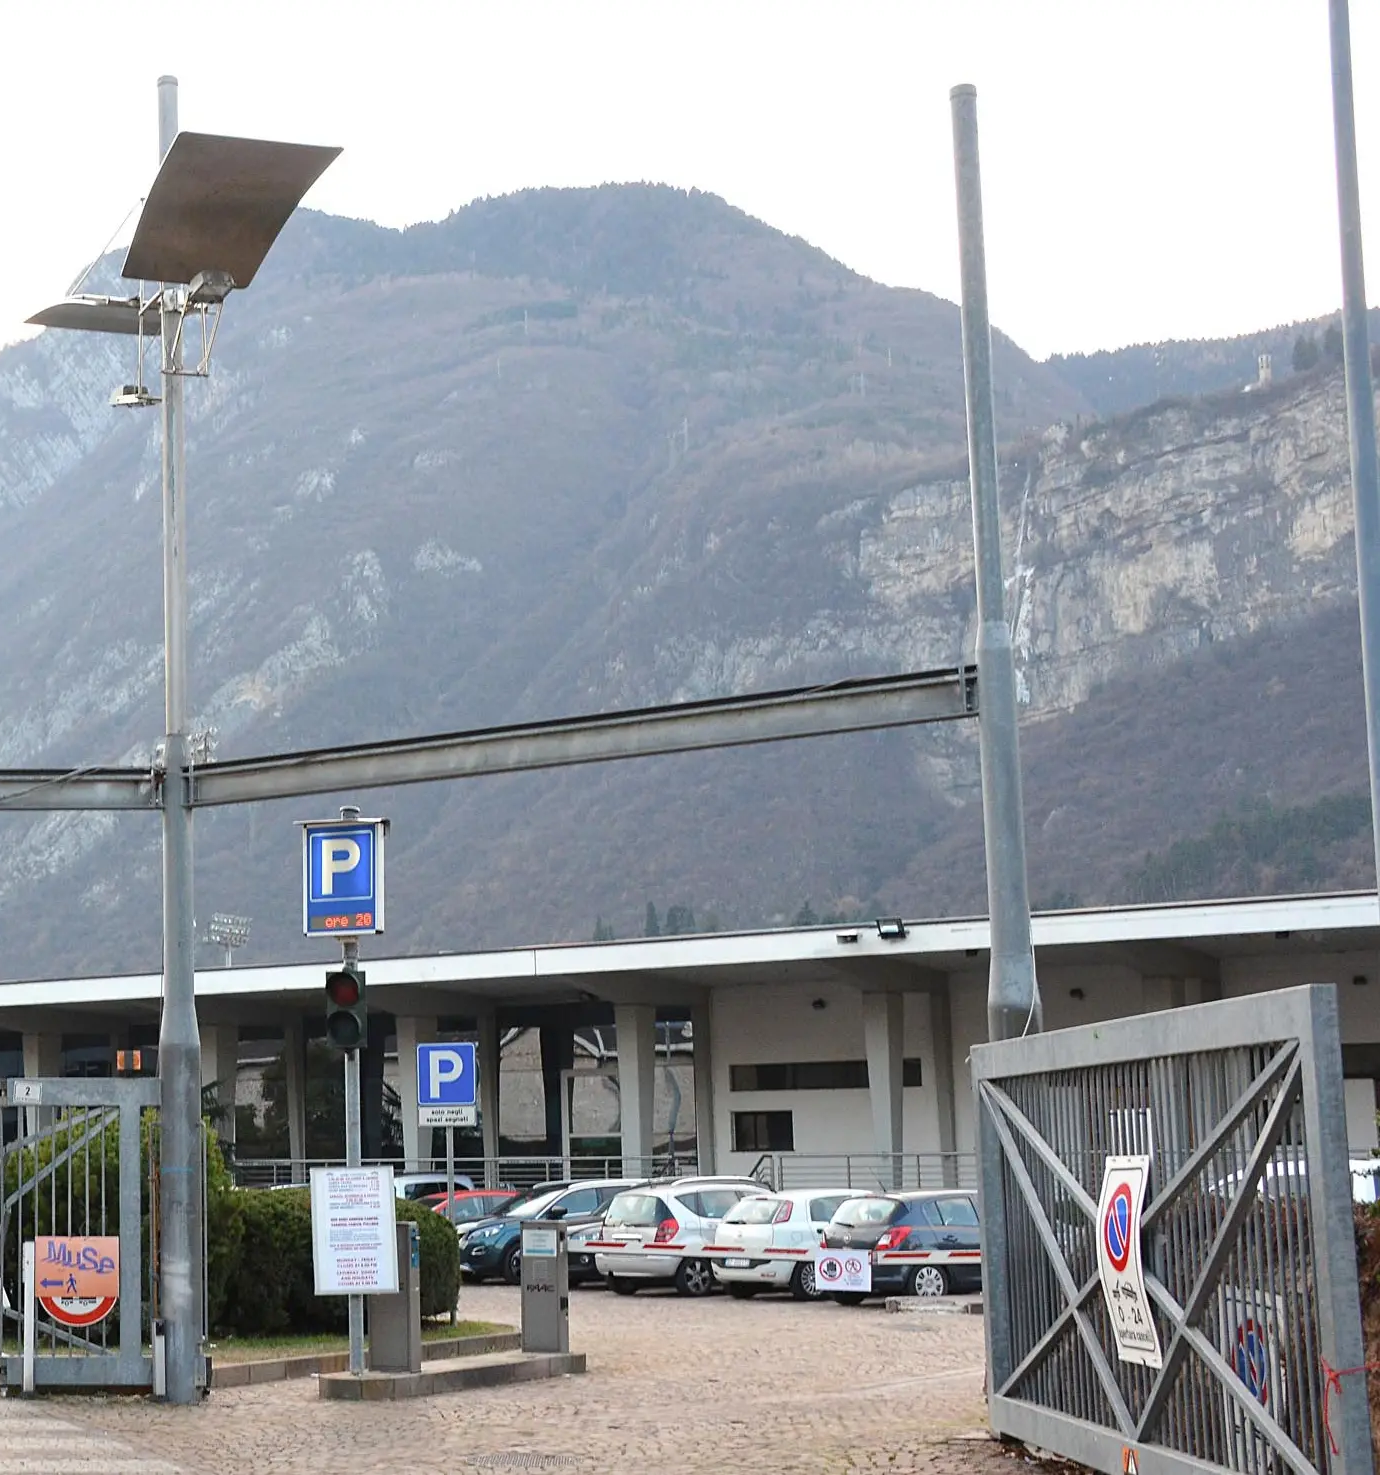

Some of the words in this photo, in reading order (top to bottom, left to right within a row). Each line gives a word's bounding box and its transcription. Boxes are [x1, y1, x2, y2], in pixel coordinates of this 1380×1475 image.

[322, 838, 360, 895] P
[325, 916, 349, 928] ore
[355, 913, 372, 927] 20
[429, 1050, 463, 1099] P
[445, 1115, 469, 1123] segnati
[447, 1108, 463, 1117] negli
[41, 1240, 116, 1274] MuSe
